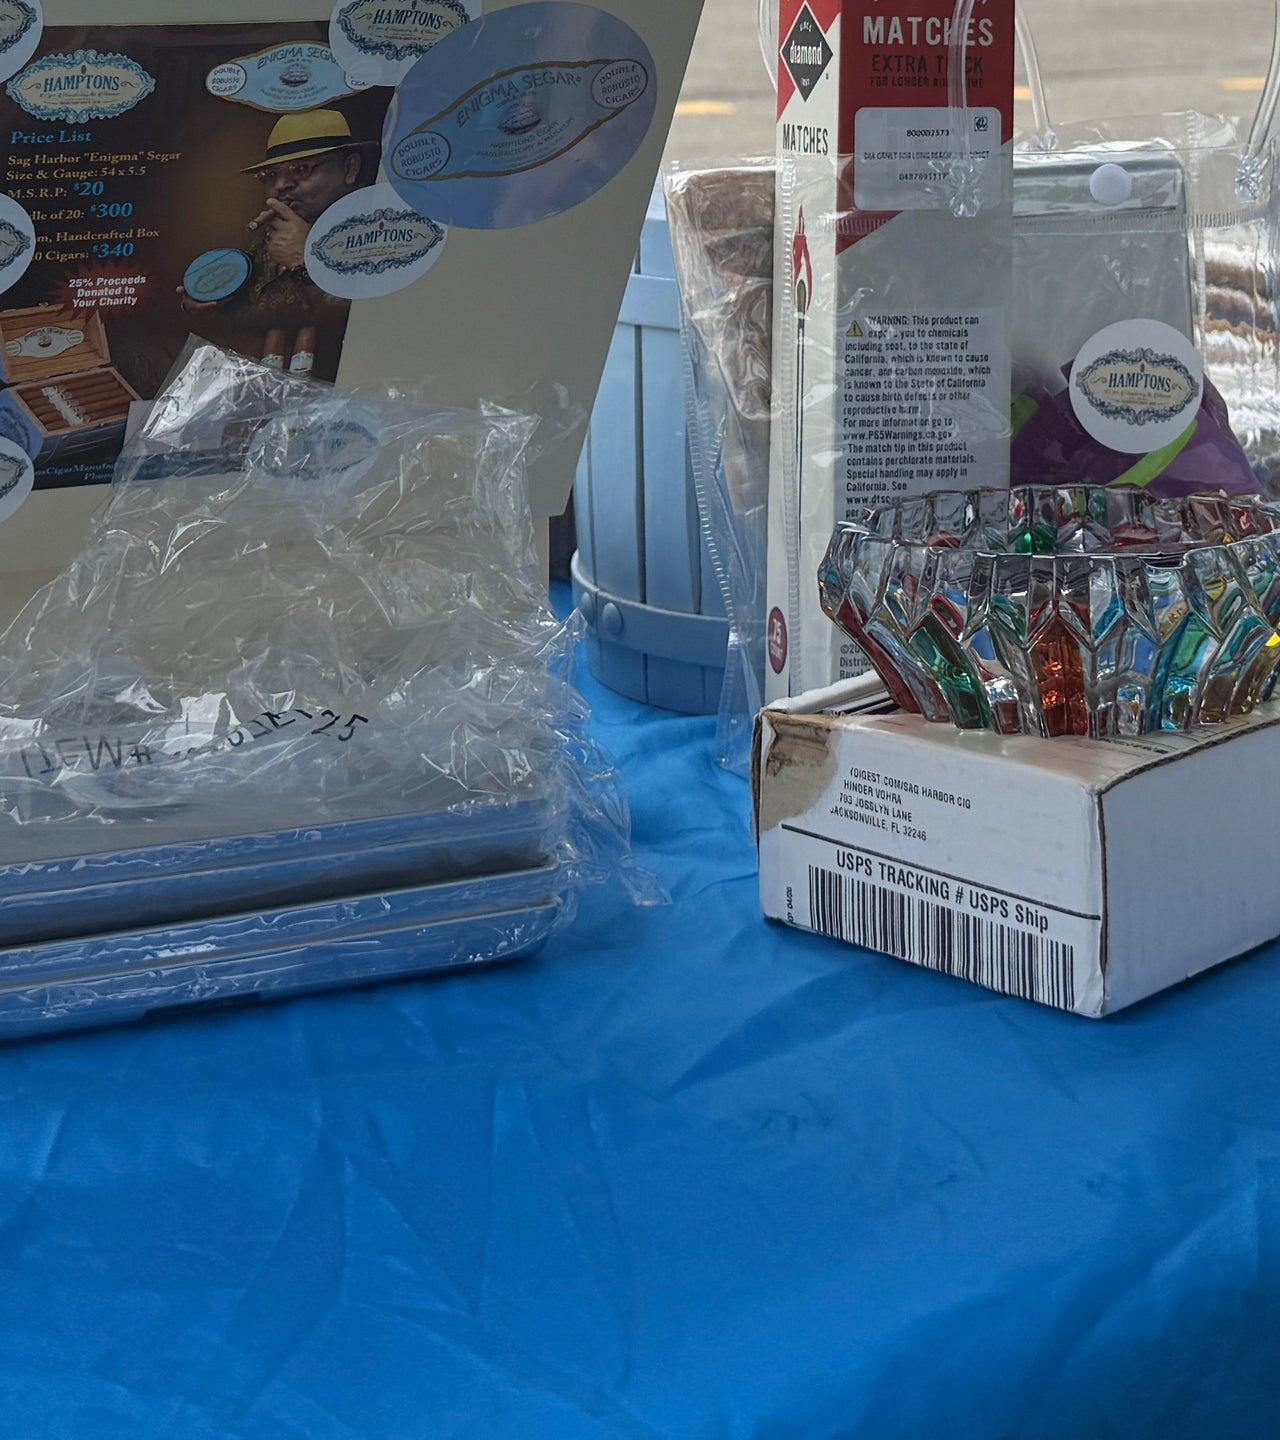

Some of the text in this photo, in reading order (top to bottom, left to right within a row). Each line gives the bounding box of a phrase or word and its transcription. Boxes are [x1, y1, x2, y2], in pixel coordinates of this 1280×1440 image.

[373, 9, 443, 30] HAMPTONS
[258, 48, 303, 69] ENIGMA
[872, 55, 928, 73] EXTRA
[599, 64, 638, 84] DOUBLE
[44, 74, 120, 93] HAMPTONS
[605, 87, 641, 104] CIGARS
[456, 80, 519, 128] ENIGMA
[11, 130, 92, 144] Price List
[782, 123, 828, 156] MATCHES
[398, 137, 437, 157] DOUBLE
[8, 151, 182, 167] Sag Harbor "Enigma" Segar
[6, 171, 33, 181] Size
[36, 169, 50, 179] &
[53, 168, 99, 181] Gauge:
[101, 167, 116, 177] 54
[128, 166, 147, 176] 5.5
[405, 159, 443, 176] CIGARS
[8, 181, 105, 199] M.S.R.P: $20
[50, 202, 134, 221] of 20: $300
[56, 229, 133, 242] Handcrafted
[137, 228, 161, 238] Box
[346, 228, 413, 249] HAMPTONS
[45, 242, 134, 261] Cigars: $340
[69, 275, 146, 287] 25% Proceeds
[77, 286, 135, 297] Donated to
[72, 296, 138, 308] Your Charity
[912, 315, 929, 325] This
[932, 315, 962, 328] product
[965, 316, 979, 325] can
[900, 328, 969, 339] you to chemicals
[845, 340, 969, 352] including to the state of
[844, 354, 888, 364] California,
[891, 354, 914, 363] which
[926, 354, 952, 362] known
[955, 353, 963, 362] to
[965, 354, 989, 362] cause
[844, 369, 875, 377] cancer,
[878, 367, 892, 376] and
[895, 367, 922, 376] carbon
[968, 365, 991, 374] which
[844, 377, 986, 390] is known to the State of California
[1108, 372, 1171, 392] HAMPTONS
[844, 394, 853, 402] to
[855, 394, 880, 402] cause
[882, 392, 902, 401] birth
[949, 391, 971, 400] other
[843, 405, 896, 416] reproductive
[843, 418, 856, 428] For
[859, 419, 880, 427] more
[931, 418, 941, 428] go
[945, 417, 953, 425] to
[848, 442, 967, 454] The match tip in this product
[847, 455, 977, 466] contains perchlorate materials.
[847, 467, 967, 480] Special handling may apply in
[847, 481, 907, 491] California. See
[844, 780, 902, 805] HINDER VOHRA
[922, 787, 955, 805] HARBOR
[855, 798, 912, 822] JOSSLYN LANE
[891, 822, 926, 840] FL 32246
[836, 849, 1050, 934] USPS TRACKING # USPS Ship
